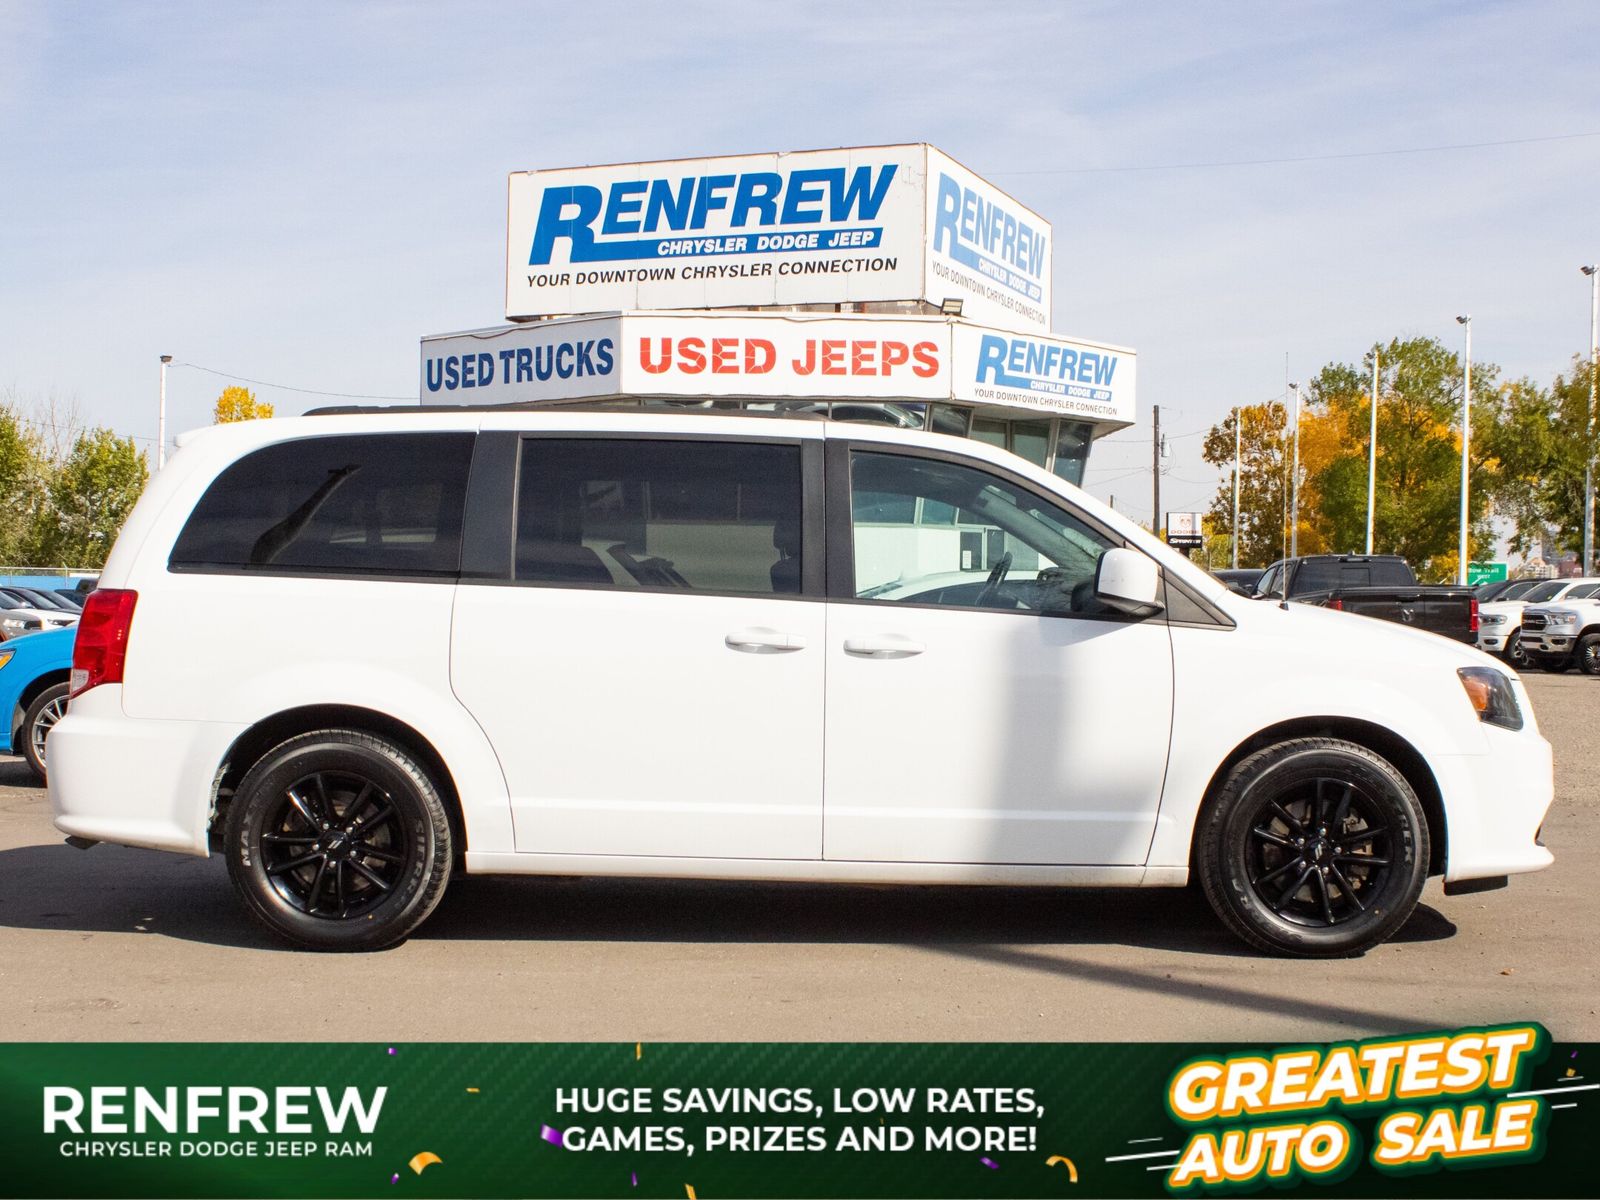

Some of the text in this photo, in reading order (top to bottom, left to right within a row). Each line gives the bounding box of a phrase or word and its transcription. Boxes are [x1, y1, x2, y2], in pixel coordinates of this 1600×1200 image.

[528, 164, 899, 266] RENFREW
[933, 172, 1045, 279] RENFREW
[657, 230, 875, 256] CHRYSLER DODGE JEEP
[527, 257, 898, 288] YOUR DOWNTOWN CHRYSLER CONNECTION
[932, 260, 1046, 325] YOUR DOWNTOWN CHRYSLER CONNECTION
[978, 258, 1041, 299] CHRYSLER DODGE JEEP
[426, 337, 614, 392] USED TRUCKS
[640, 336, 939, 378] USED JEEPS
[975, 334, 1118, 386] RENFREW
[974, 388, 1118, 415] YOUR DOWNTOWN CHRYSLER CONNECTION
[1030, 380, 1111, 400] CHRYSLER DODGE JEEP
